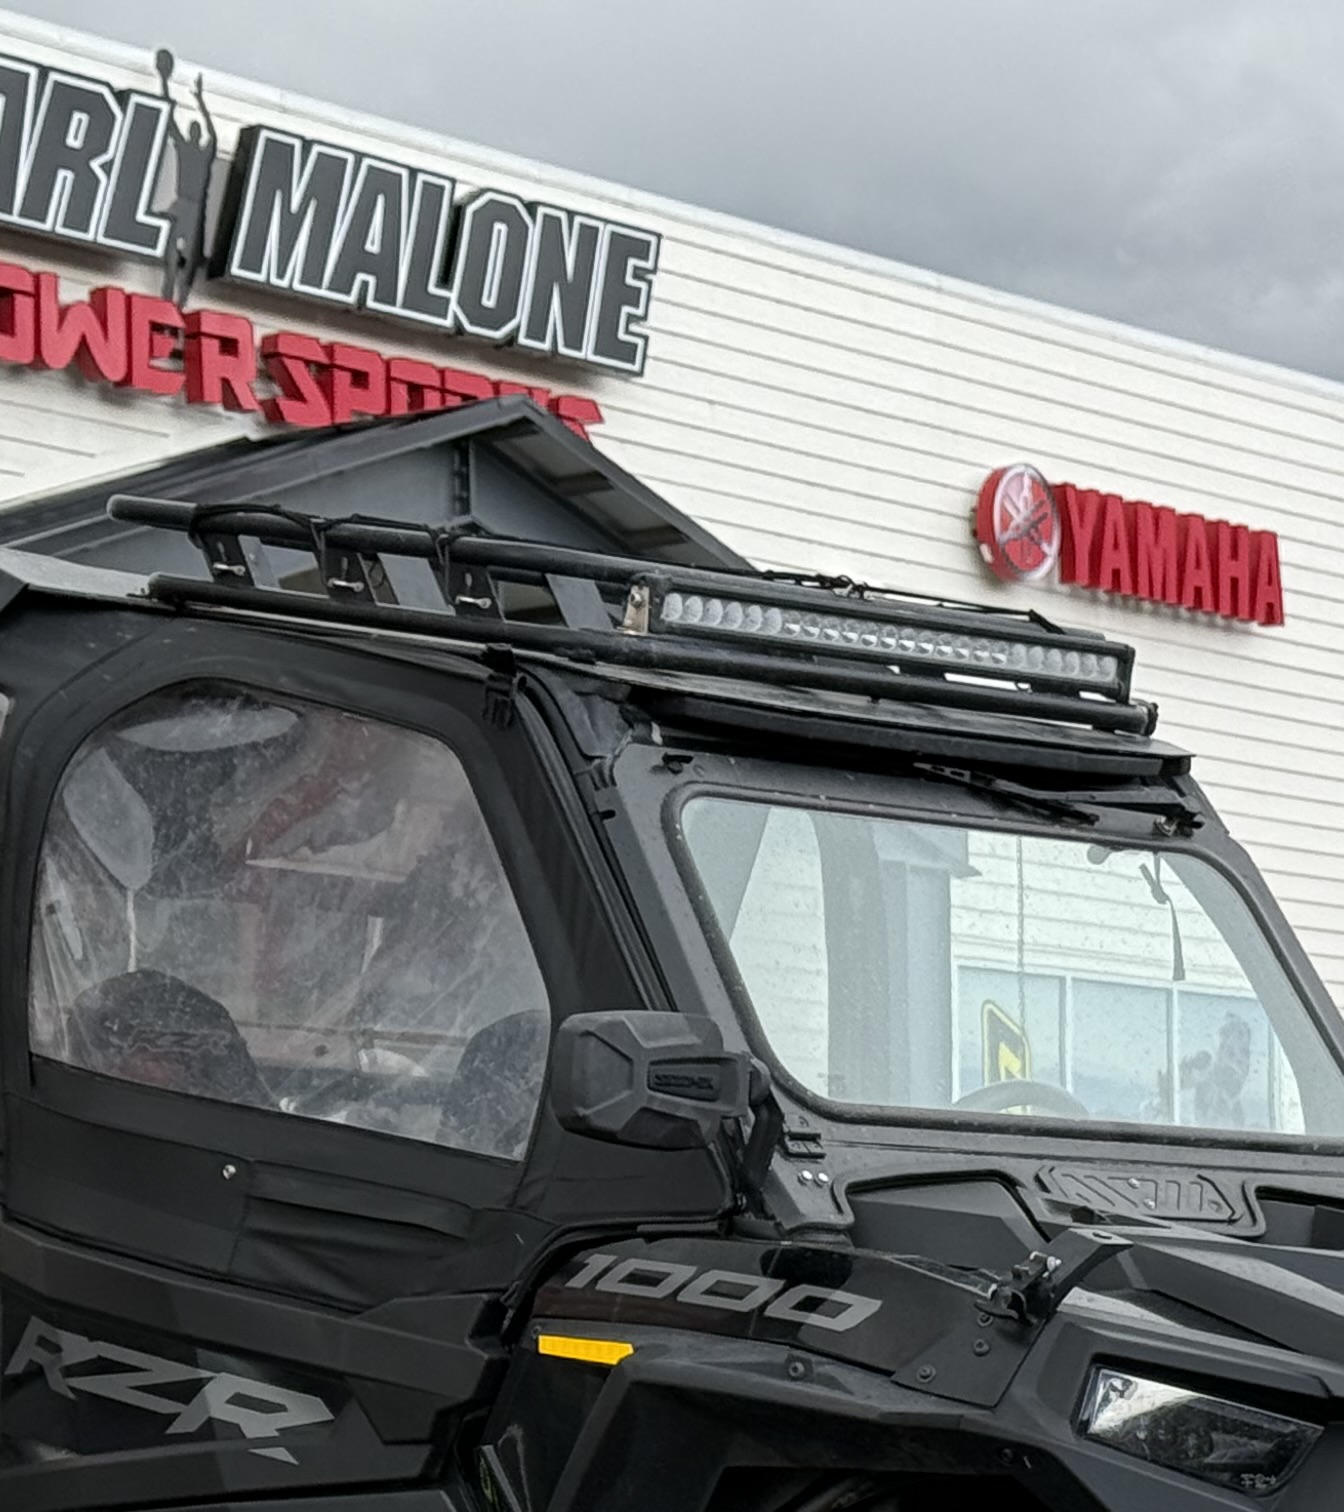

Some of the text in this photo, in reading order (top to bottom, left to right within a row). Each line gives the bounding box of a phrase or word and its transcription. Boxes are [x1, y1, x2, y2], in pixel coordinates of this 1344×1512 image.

[229, 129, 660, 377] MALONE
[1058, 483, 1284, 626] YAMAHA
[564, 1253, 883, 1332] 1000
[4, 1315, 335, 1466] RZR
